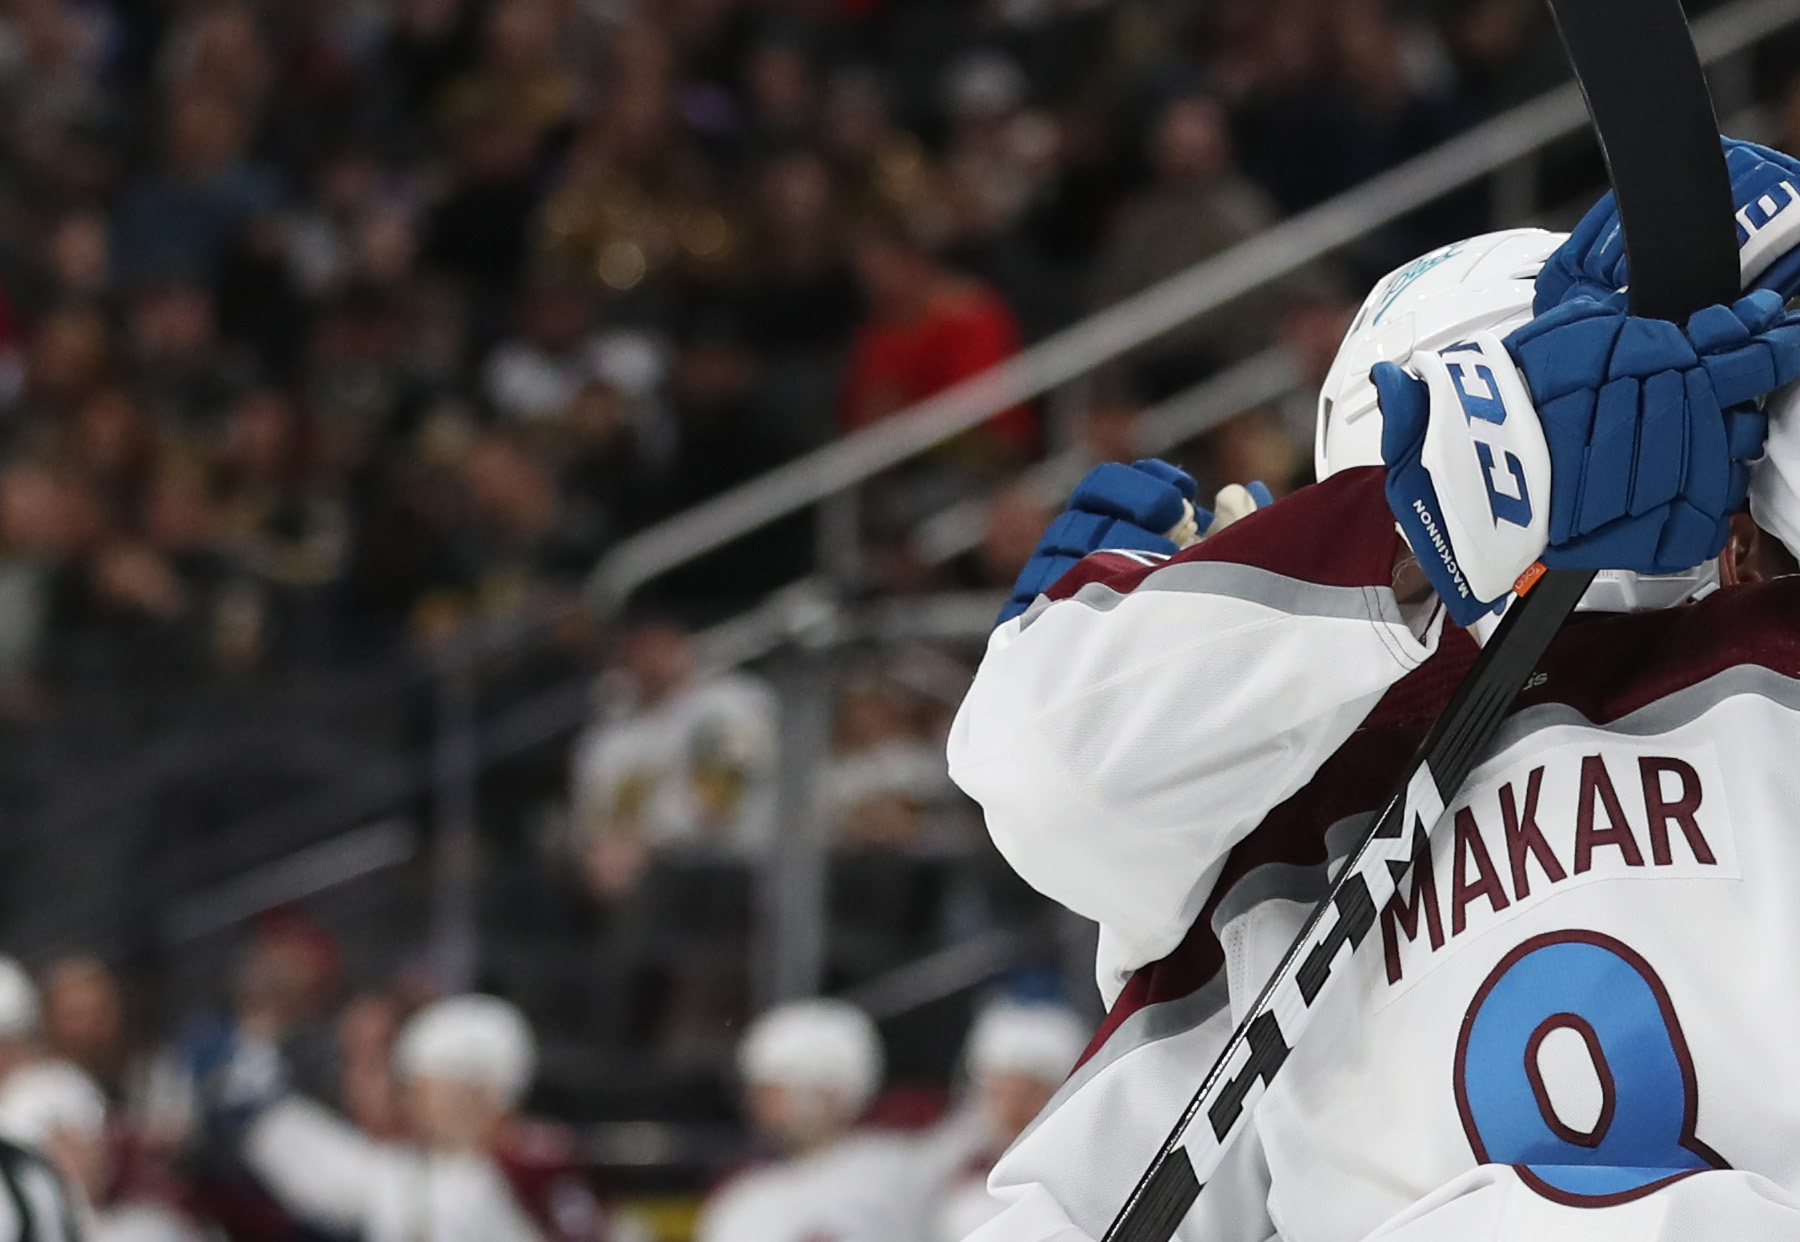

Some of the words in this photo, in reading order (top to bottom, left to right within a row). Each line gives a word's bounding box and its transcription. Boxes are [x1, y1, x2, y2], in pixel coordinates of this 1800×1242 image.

[1412, 499, 1470, 600] MACKINNON
[1171, 760, 1446, 1185] CCM
[1383, 754, 1717, 987] MAKAR
